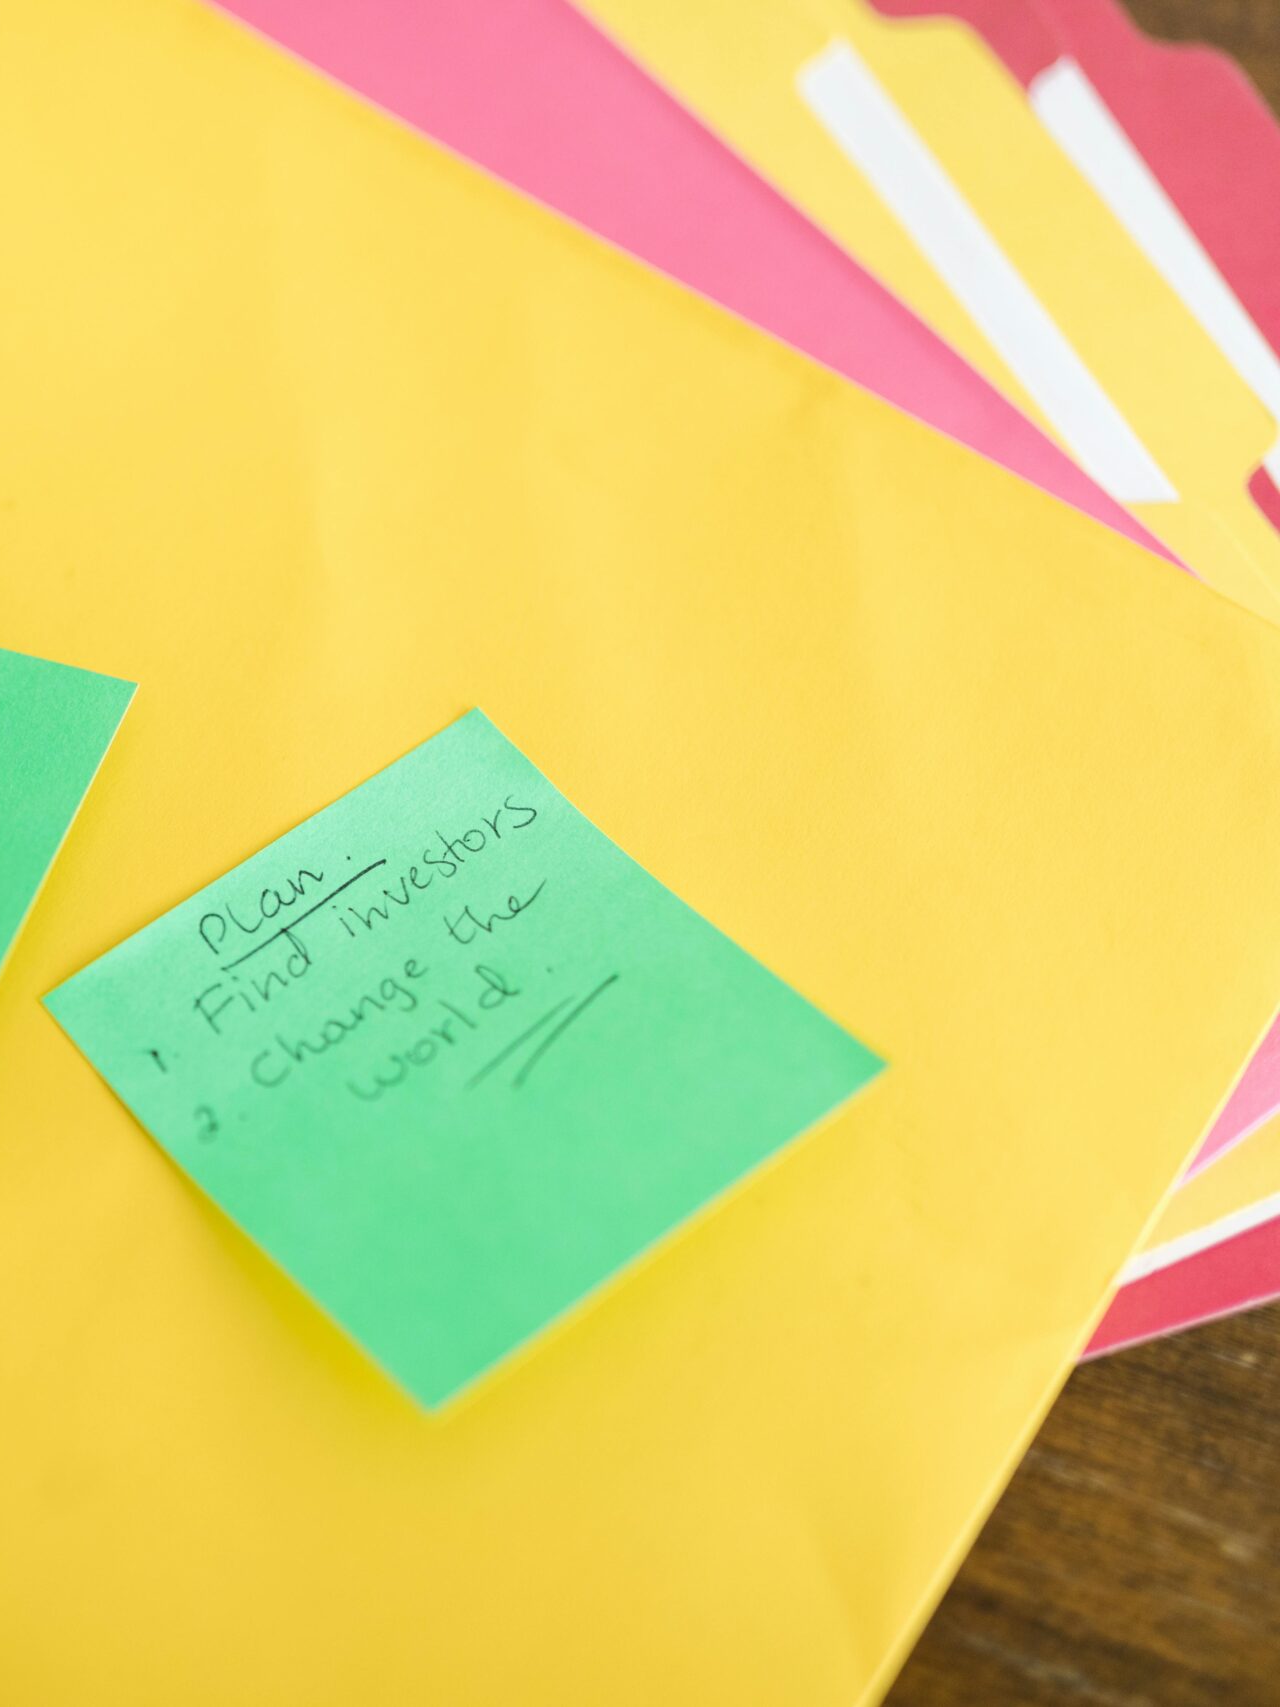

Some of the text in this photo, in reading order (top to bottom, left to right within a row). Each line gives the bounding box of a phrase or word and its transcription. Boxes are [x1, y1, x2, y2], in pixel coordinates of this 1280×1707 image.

[193, 927, 312, 1035] Find
[333, 795, 538, 938] investors
[443, 879, 547, 945] the
